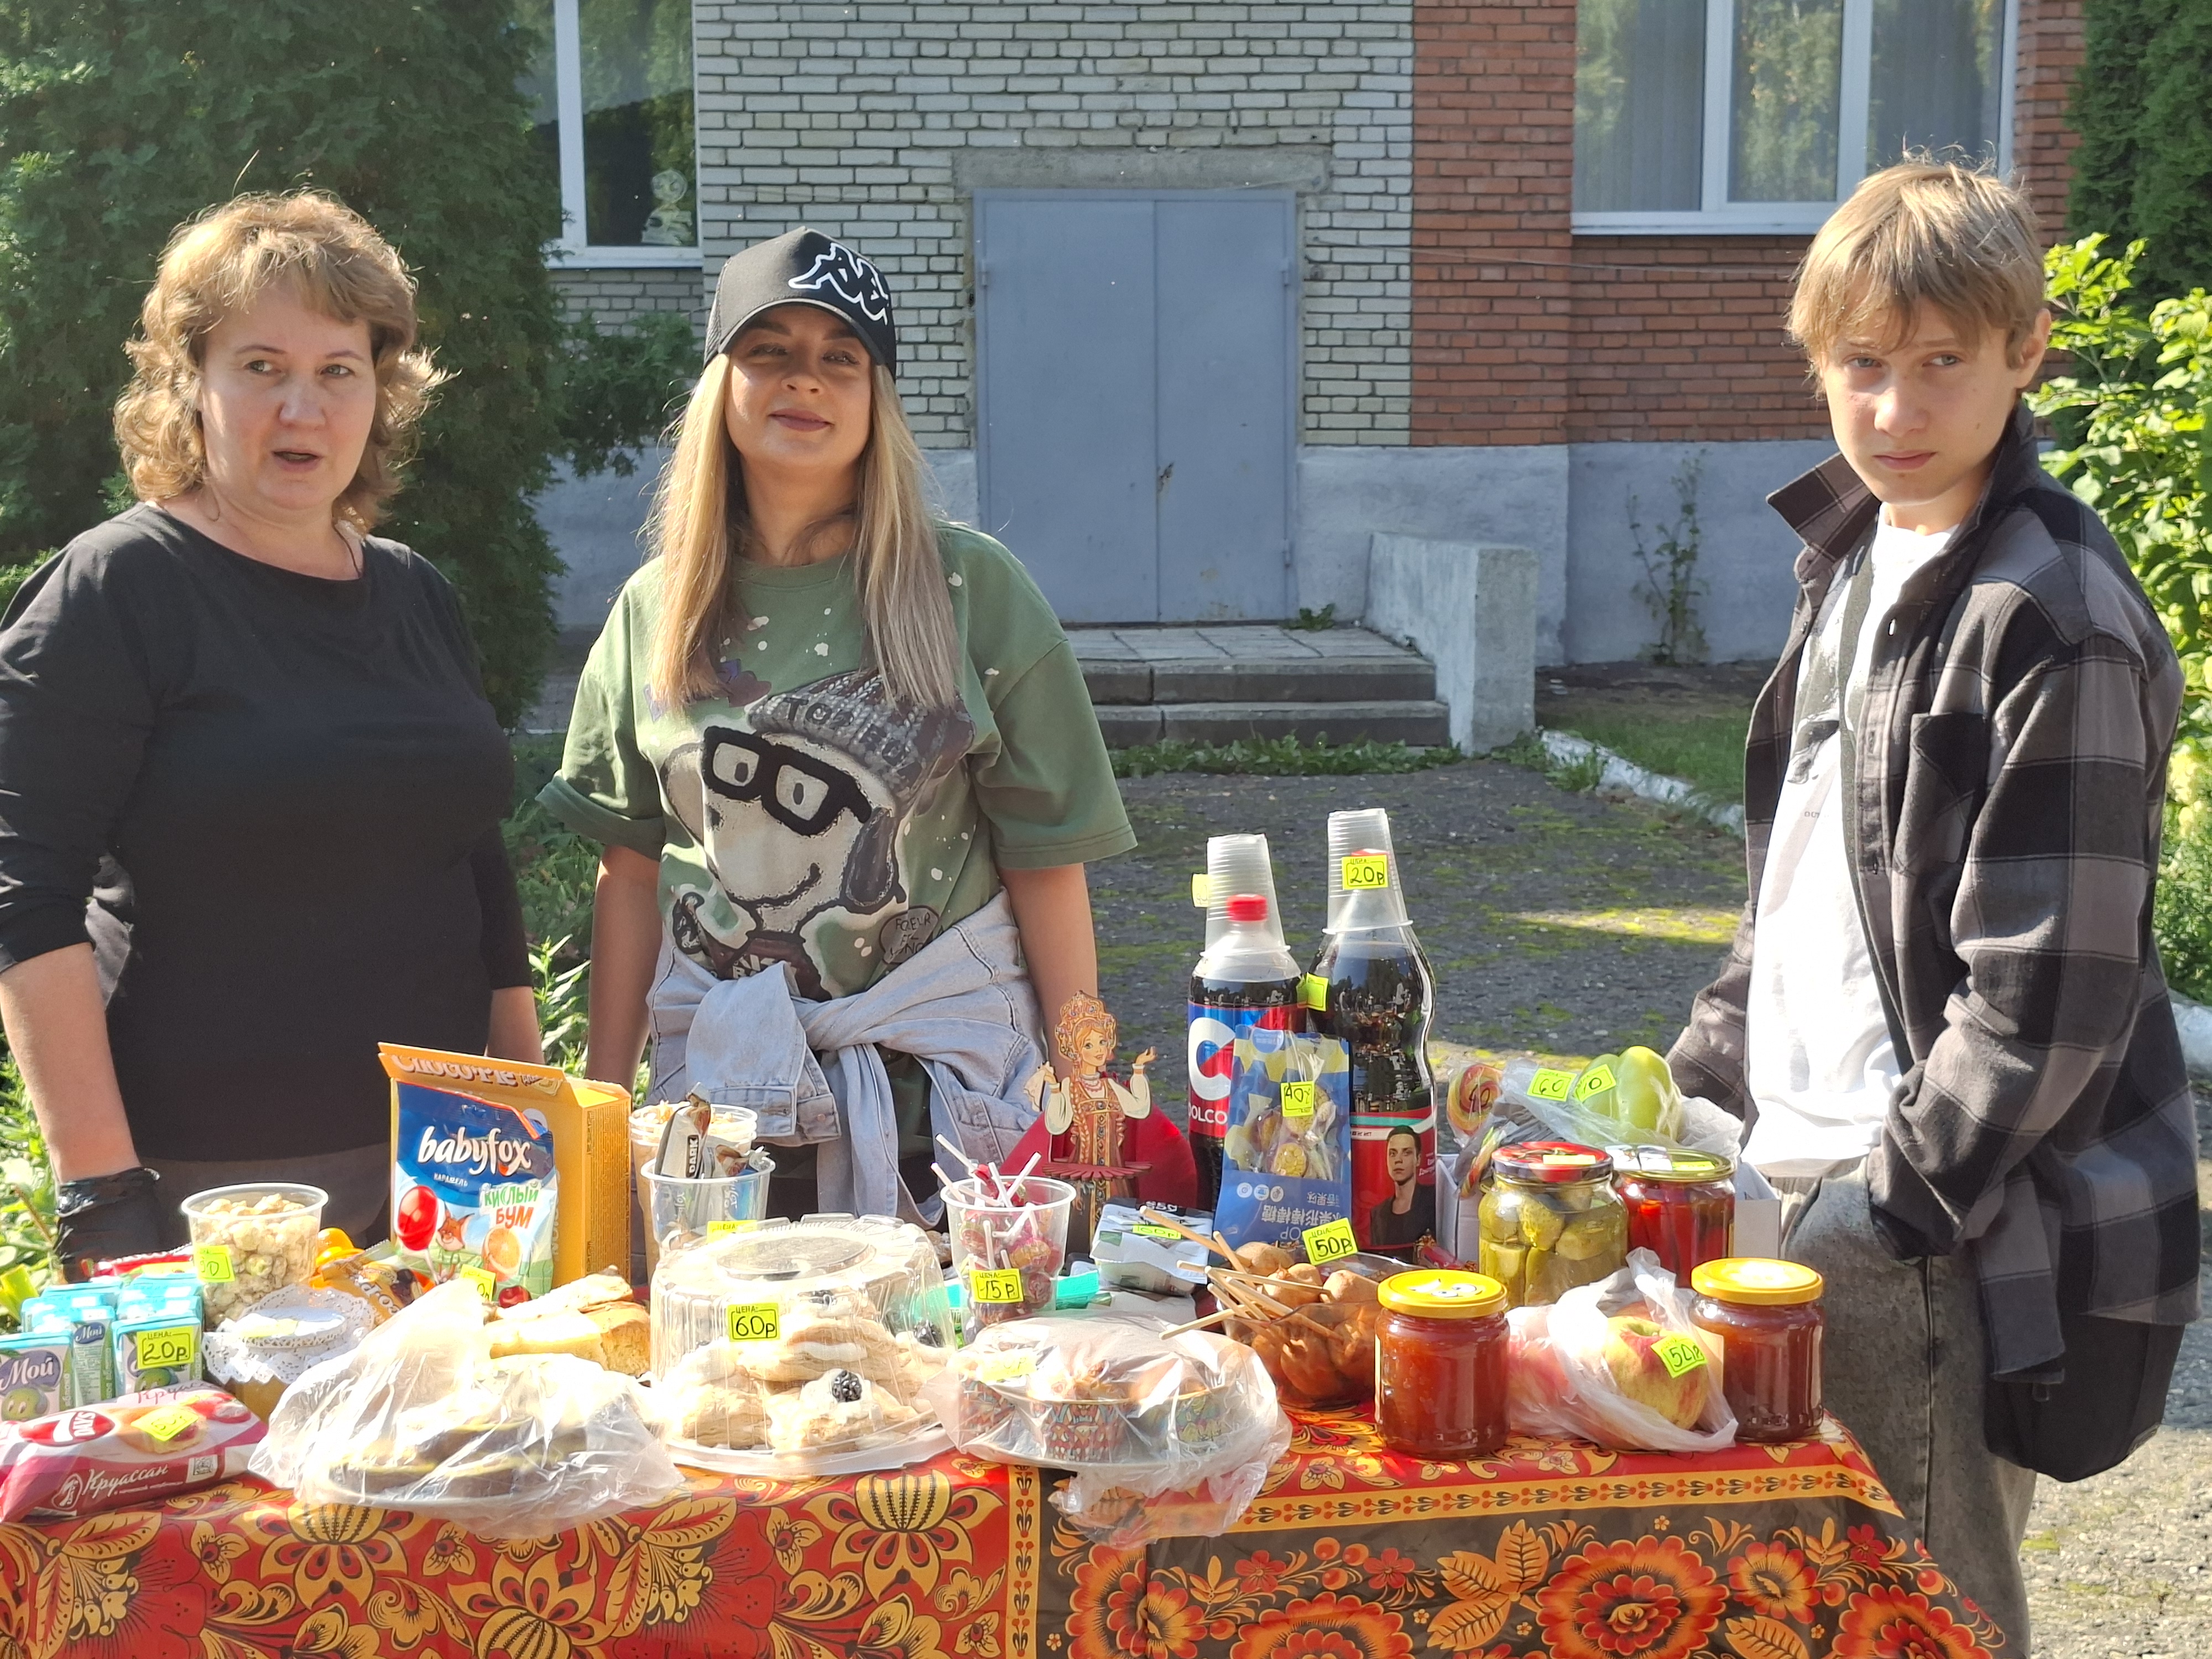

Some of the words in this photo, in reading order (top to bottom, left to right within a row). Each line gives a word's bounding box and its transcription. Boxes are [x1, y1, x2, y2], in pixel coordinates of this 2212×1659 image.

[418, 1125, 531, 1176] babyfox
[688, 1138, 698, 1174] DARK
[495, 1206, 534, 1229] БУМ
[735, 1316, 775, 1338] 60р
[0, 1357, 54, 1391] Мой
[72, 1411, 96, 1437] DAYS
[81, 1463, 169, 1499] Круассан
